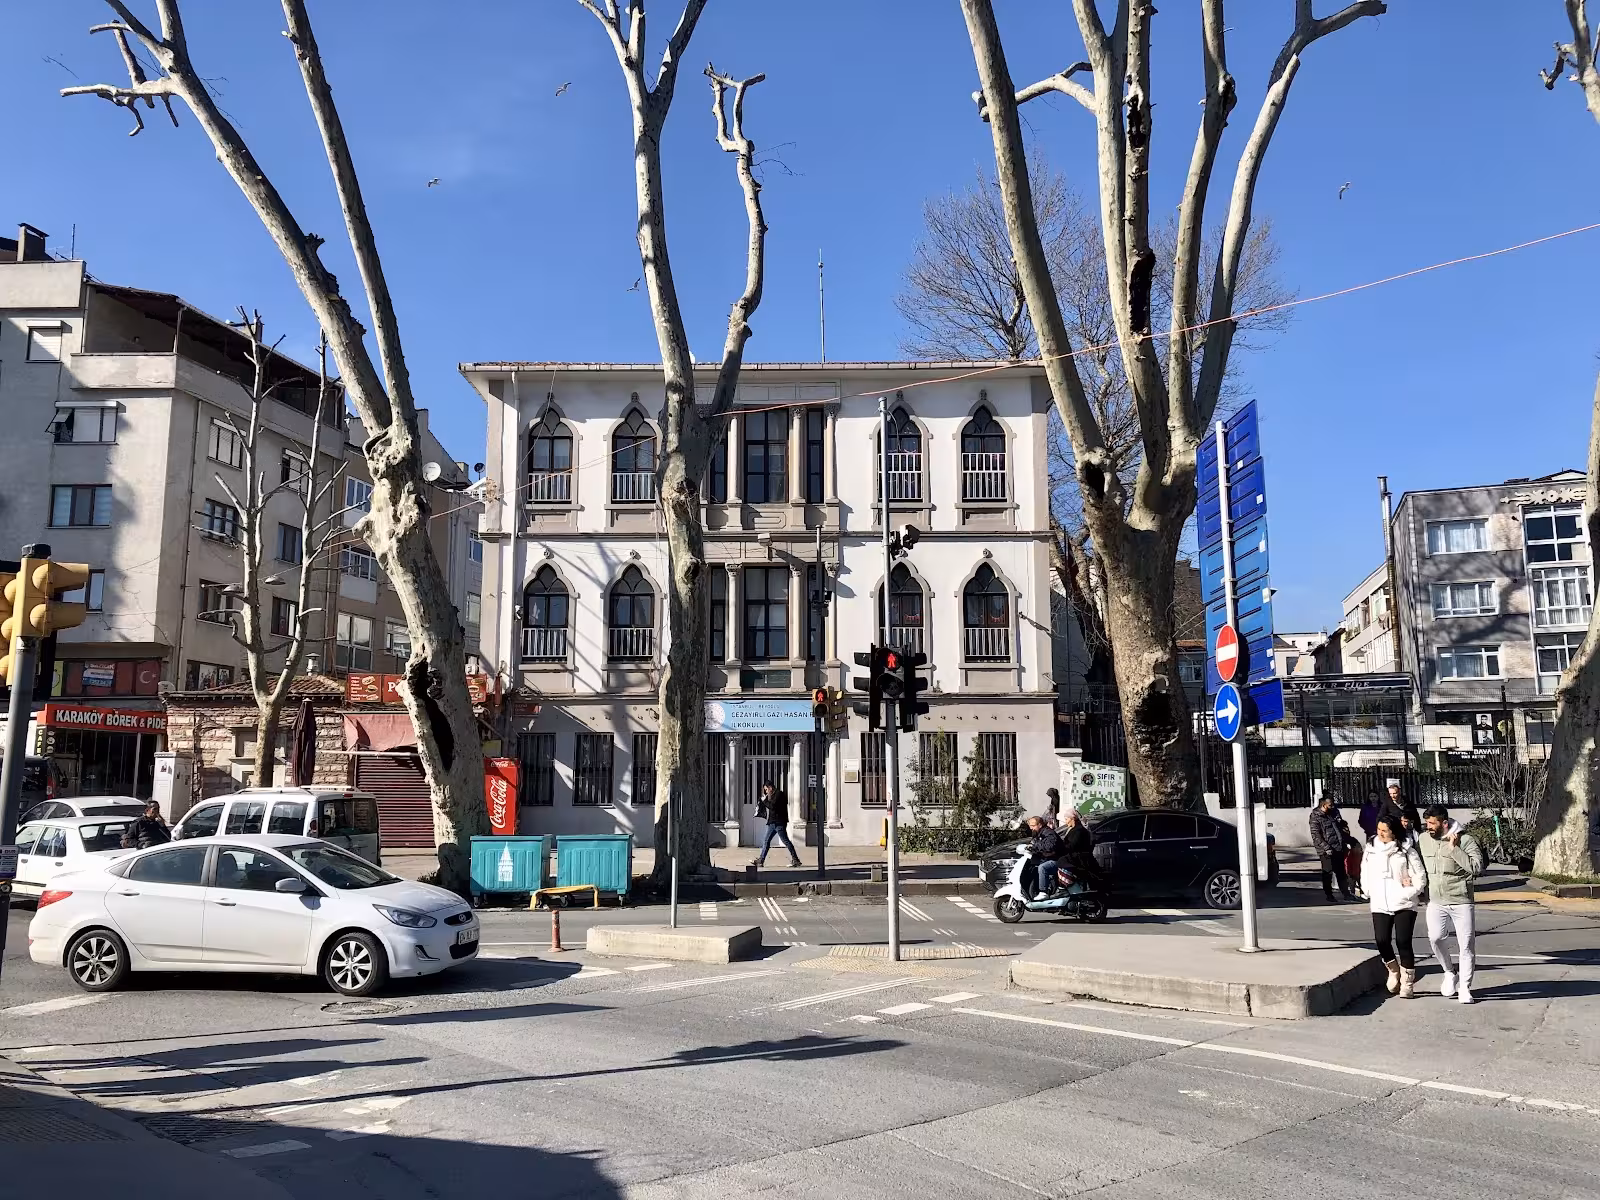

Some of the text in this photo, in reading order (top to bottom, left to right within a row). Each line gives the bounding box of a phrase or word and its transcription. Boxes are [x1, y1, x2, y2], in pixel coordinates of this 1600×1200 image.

[56, 709, 167, 730] KARAKÖY BÖREK & PİDE
